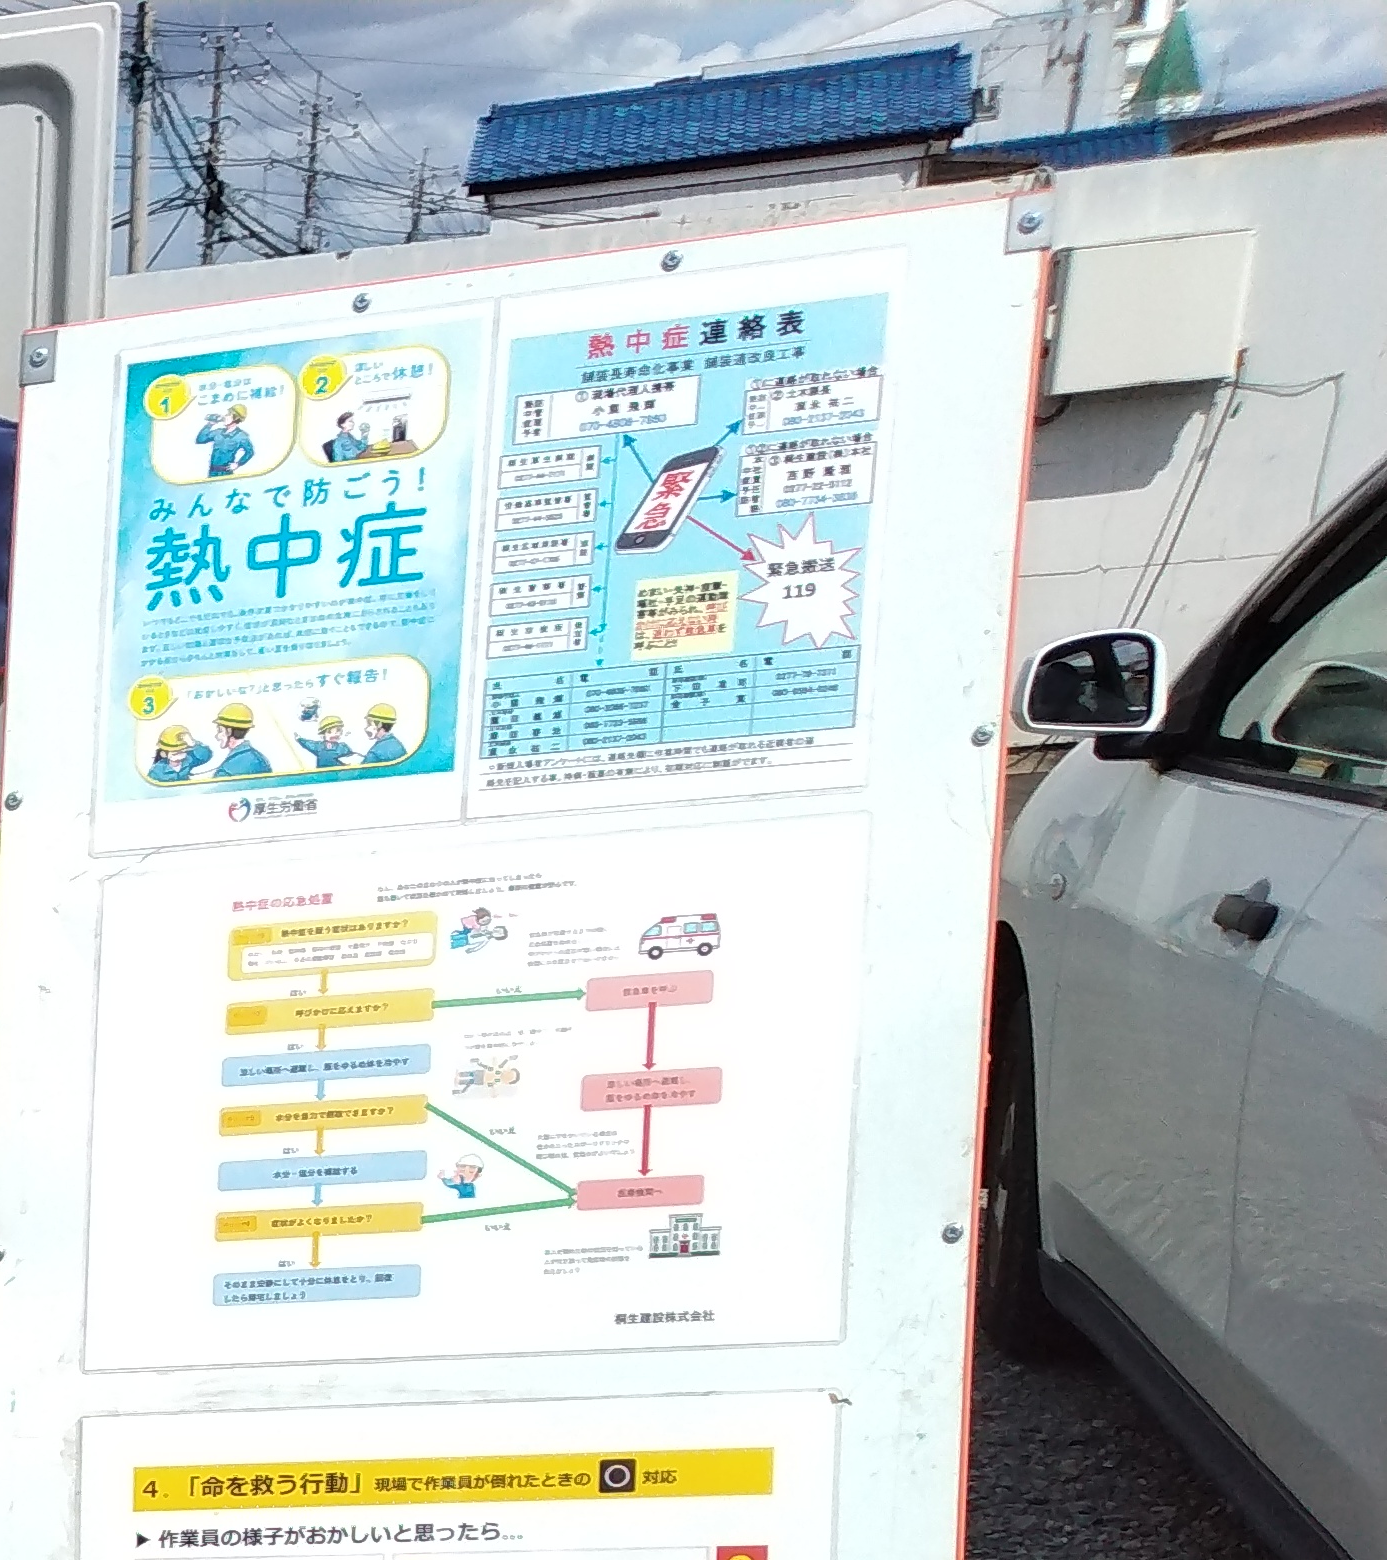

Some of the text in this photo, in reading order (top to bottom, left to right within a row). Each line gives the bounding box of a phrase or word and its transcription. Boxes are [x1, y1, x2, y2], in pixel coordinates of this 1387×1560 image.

[148, 467, 425, 522] みんなで防ごう！
[146, 501, 427, 610] 熱中症
[783, 583, 816, 599] 119
[615, 1309, 715, 1325] 桐生建設株式会社
[642, 1469, 677, 1485] 対応
